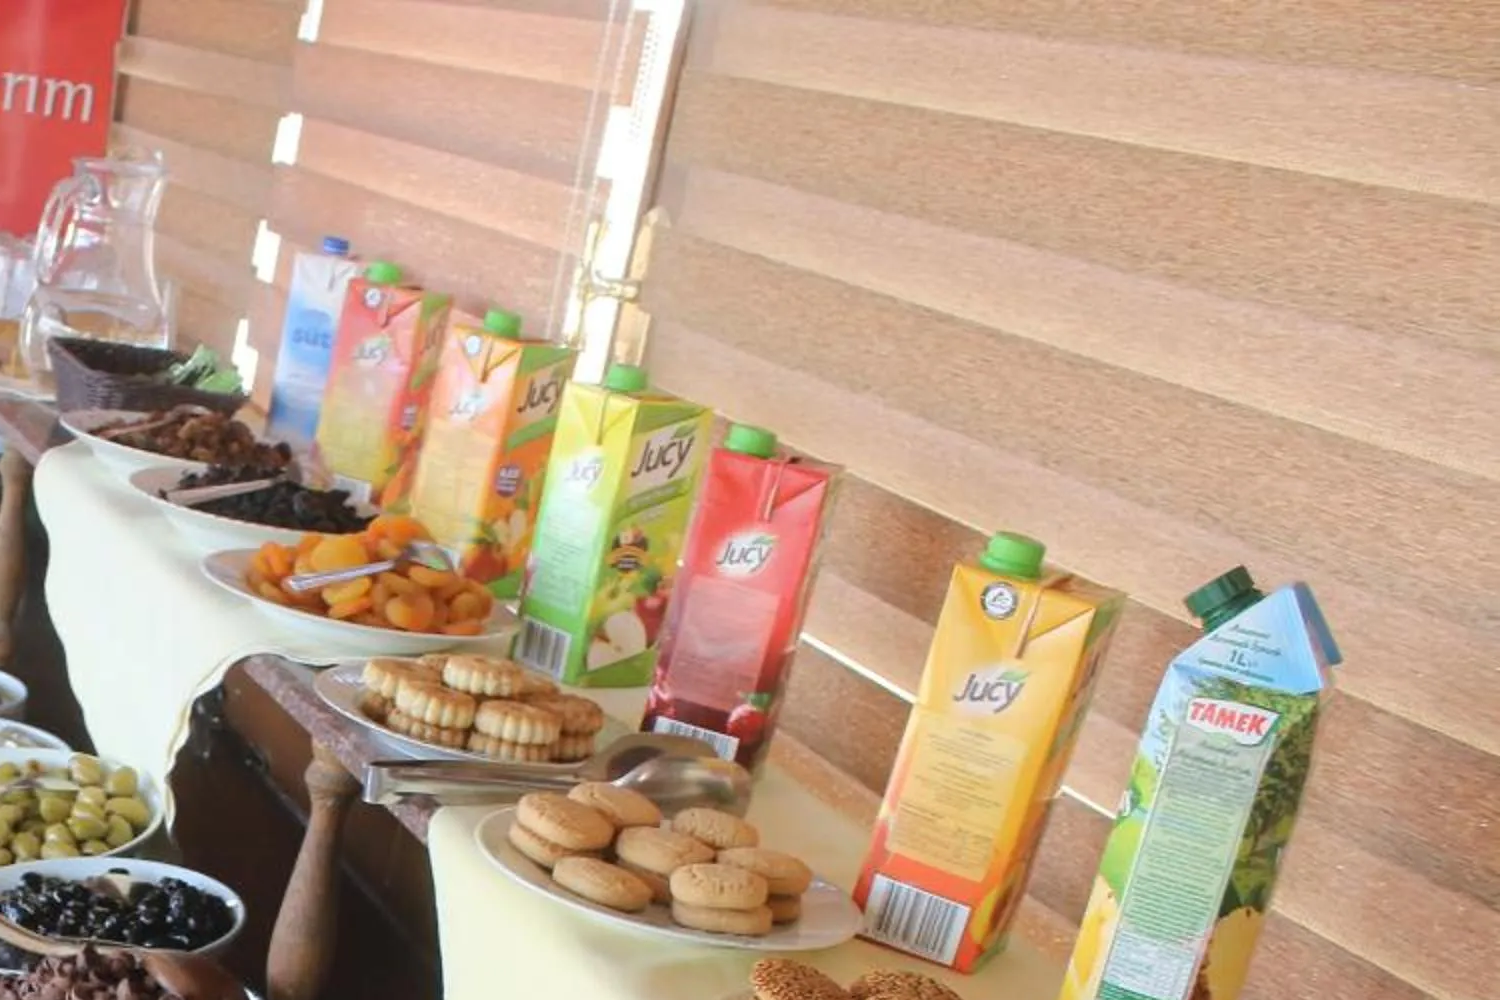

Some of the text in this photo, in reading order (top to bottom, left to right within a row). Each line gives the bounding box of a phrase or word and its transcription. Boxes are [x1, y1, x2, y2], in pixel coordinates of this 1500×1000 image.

[631, 436, 695, 479] Jucy
[716, 540, 772, 573] Jucy
[953, 672, 1025, 714] Jucy
[1189, 701, 1269, 737] TAMEK
